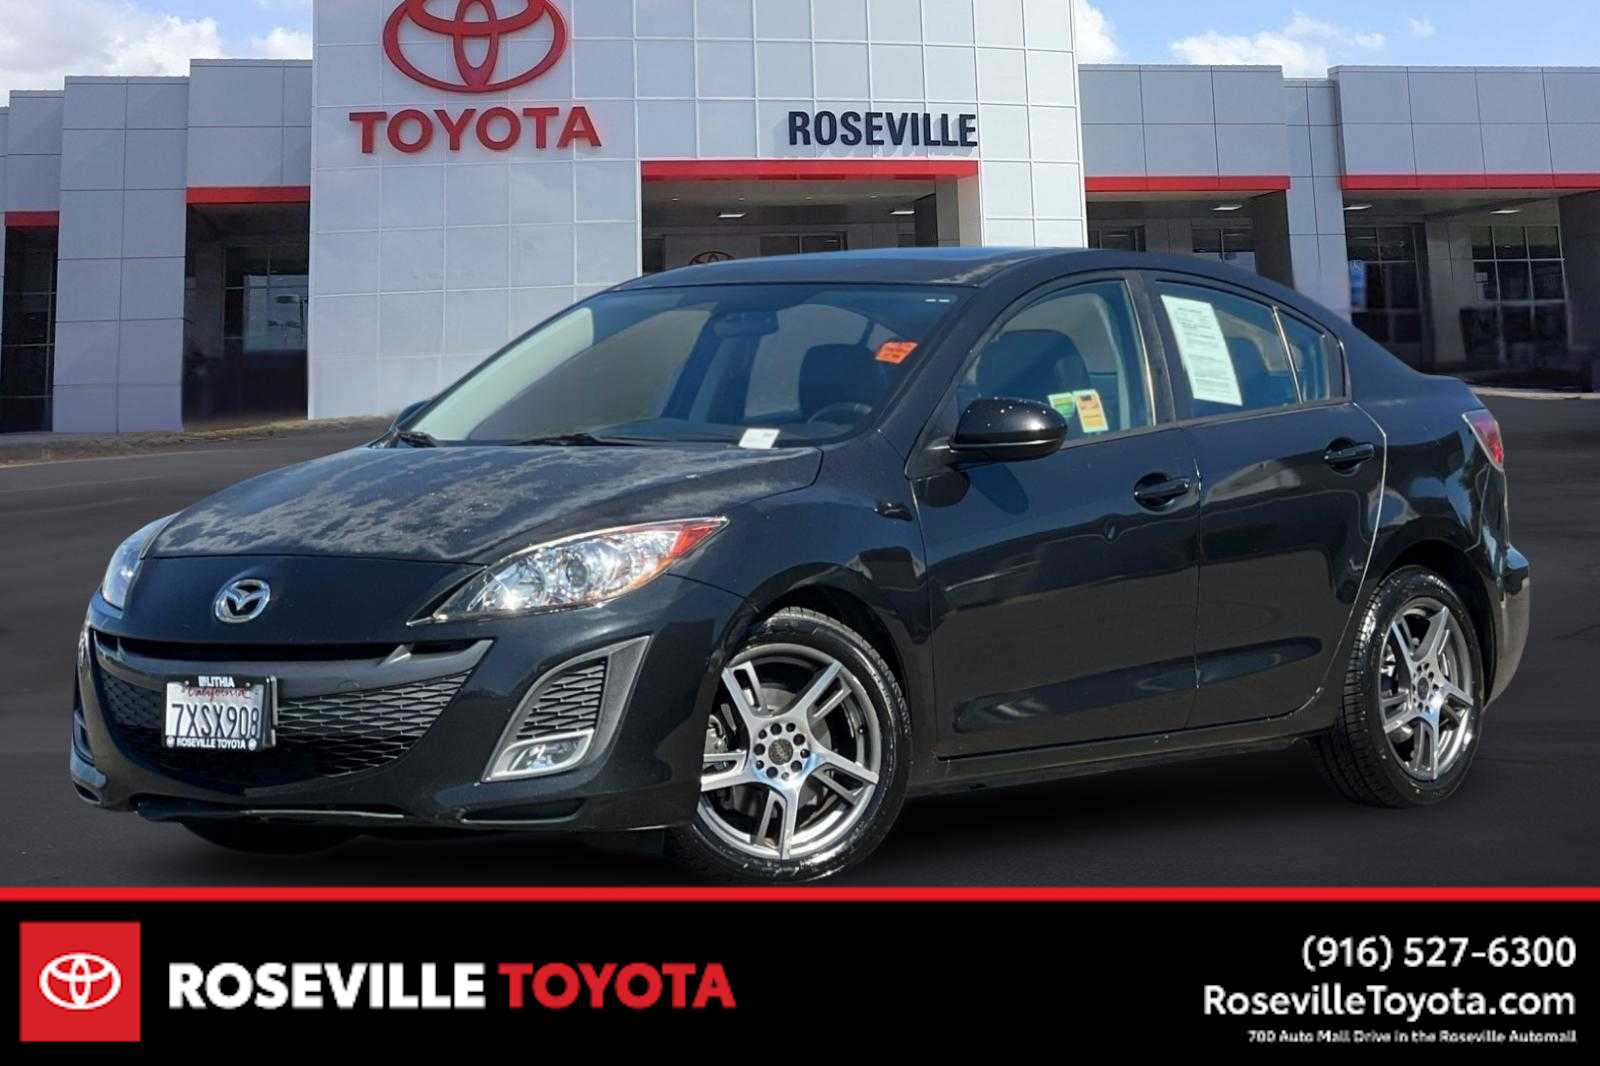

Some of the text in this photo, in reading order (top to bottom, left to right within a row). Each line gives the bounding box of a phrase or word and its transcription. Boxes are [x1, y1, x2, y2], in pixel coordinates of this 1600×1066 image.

[350, 106, 602, 154] TOYOTA
[788, 110, 978, 147] ROSEVILLE
[172, 703, 260, 739] 7XSX908
[177, 737, 246, 749] ROSEVILLE TOYOTA
